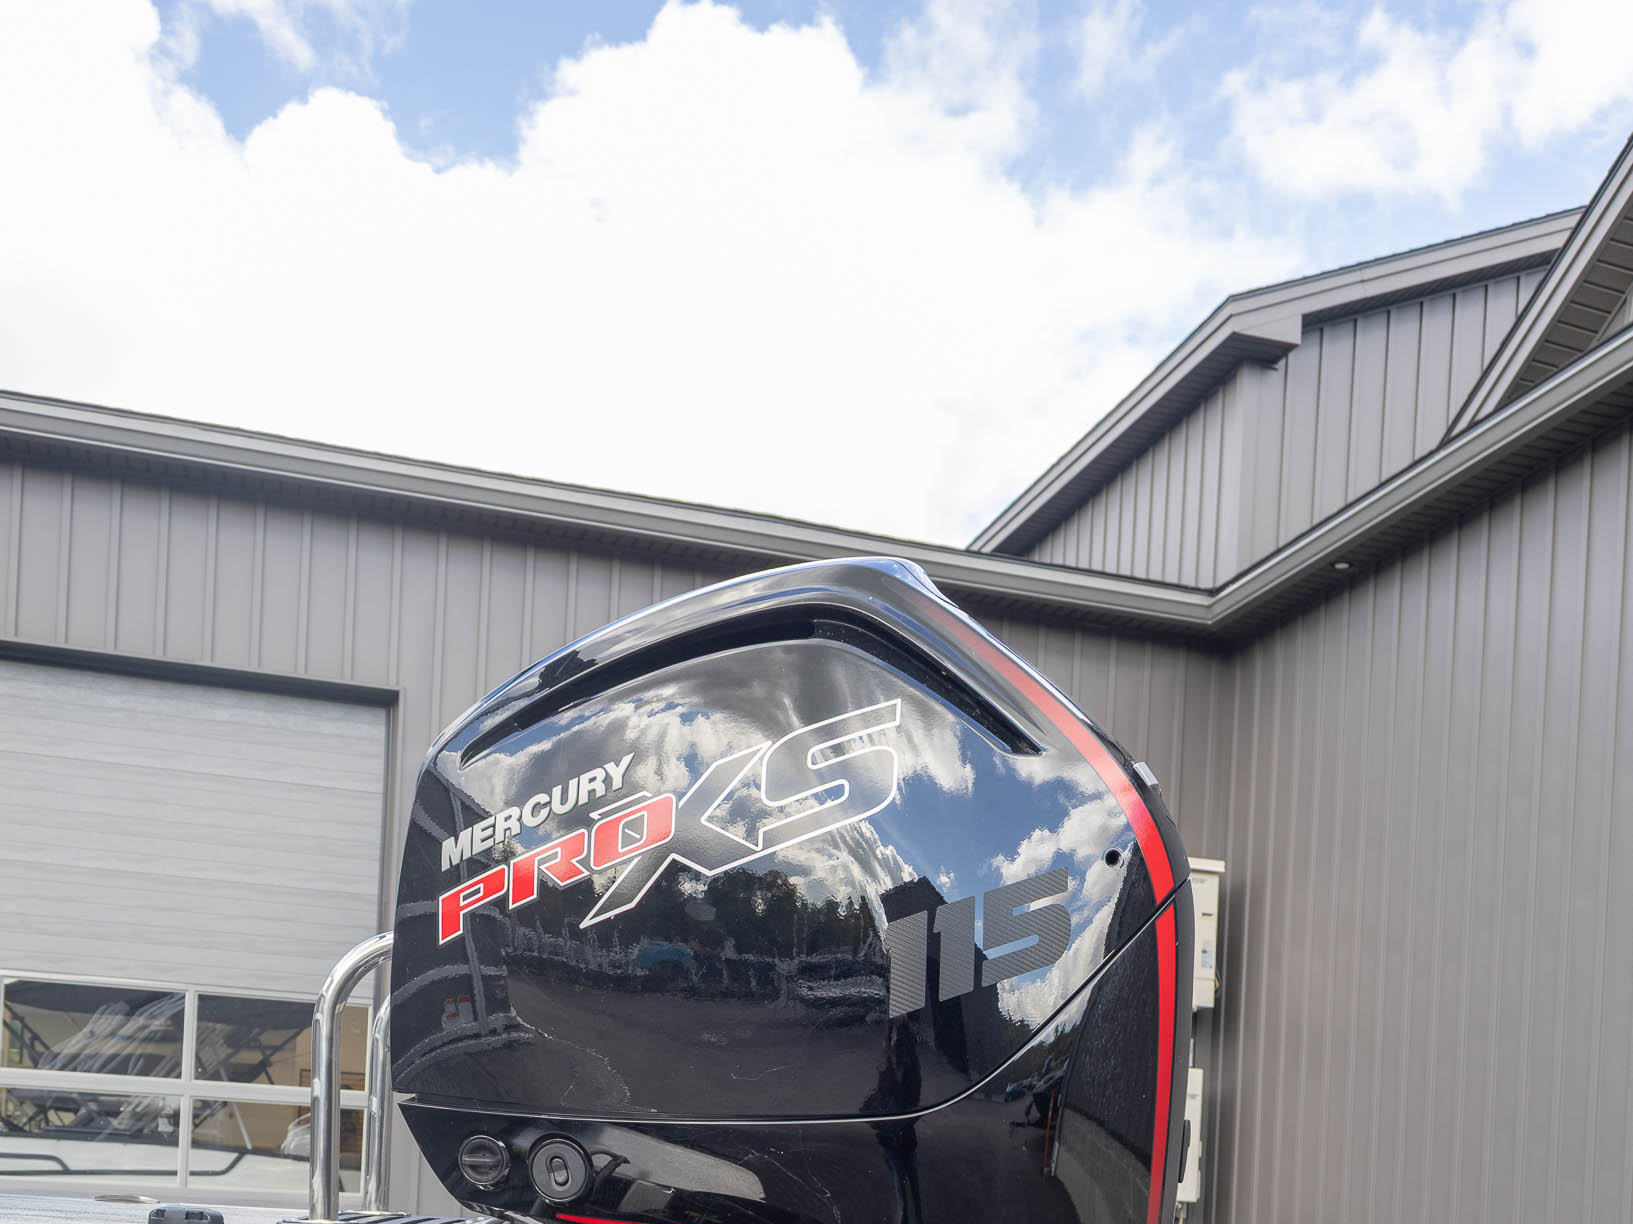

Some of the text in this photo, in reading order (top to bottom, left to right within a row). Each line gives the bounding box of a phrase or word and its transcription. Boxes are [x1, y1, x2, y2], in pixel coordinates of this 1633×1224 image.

[438, 792, 676, 945] PRO
[441, 752, 635, 872] MERCURY
[885, 866, 1072, 1019] 115
